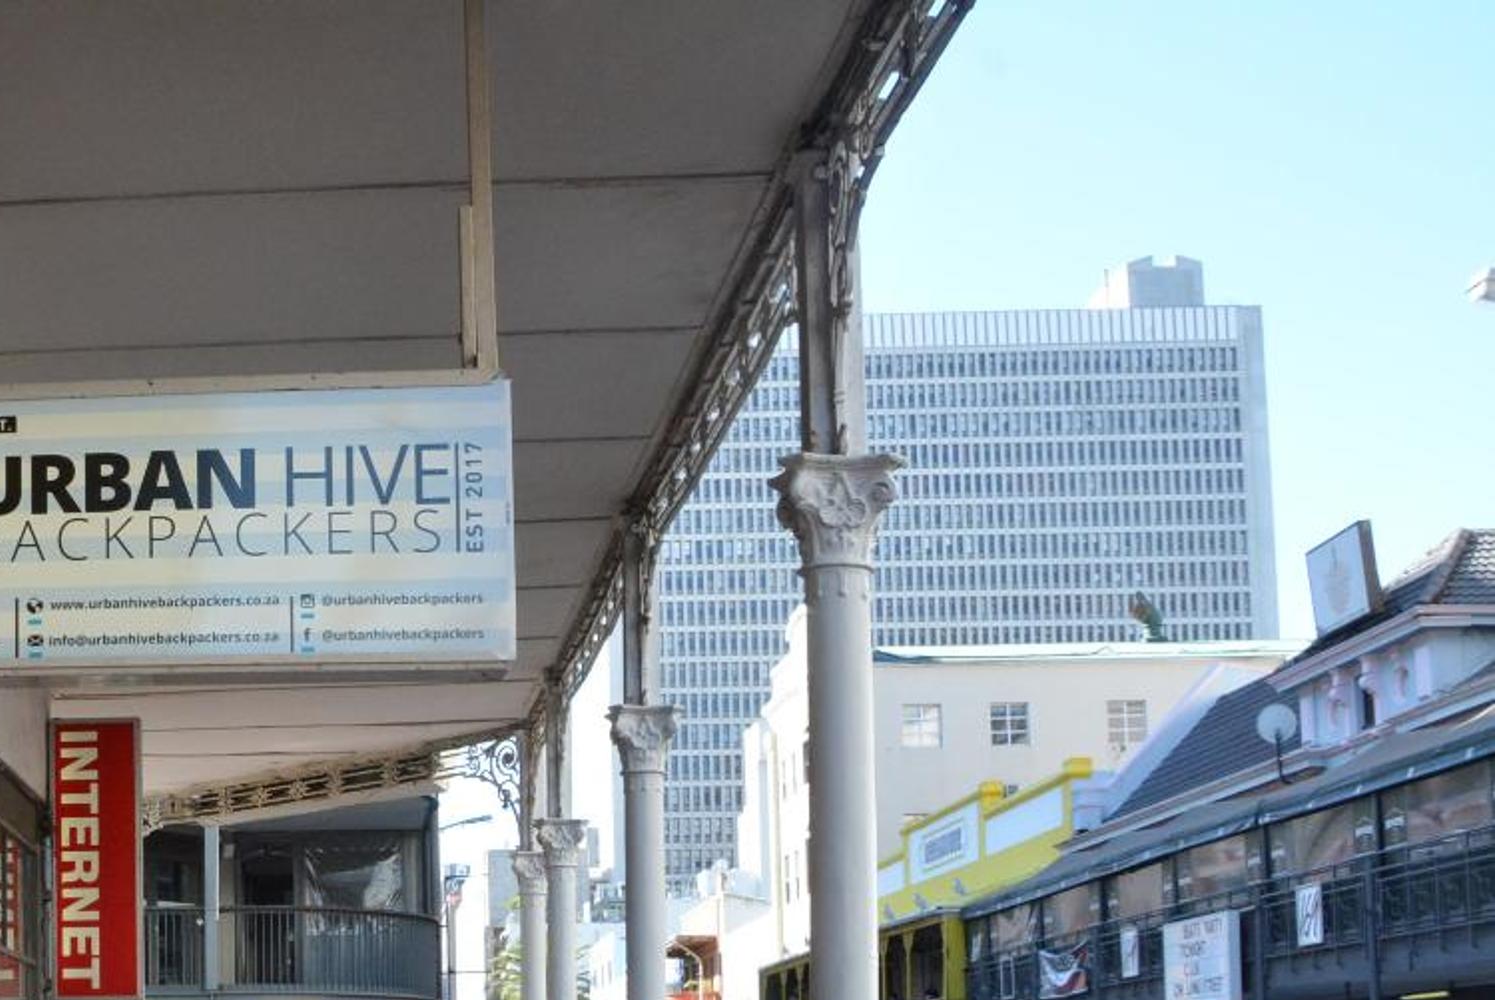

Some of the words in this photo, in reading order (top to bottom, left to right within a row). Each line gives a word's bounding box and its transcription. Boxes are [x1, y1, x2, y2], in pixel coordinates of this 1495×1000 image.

[286, 443, 450, 507] HIVE
[465, 442, 483, 498] 2017
[465, 508, 484, 553] EST
[50, 596, 280, 611] www.urbanhivebackpackers.co.za
[321, 592, 483, 607] @urbanhivebackpackers
[48, 632, 280, 647] info@urbanhivebackpackers.co.za
[322, 628, 485, 642] @urbanhivebackpackers
[60, 731, 101, 990] INTERNET
